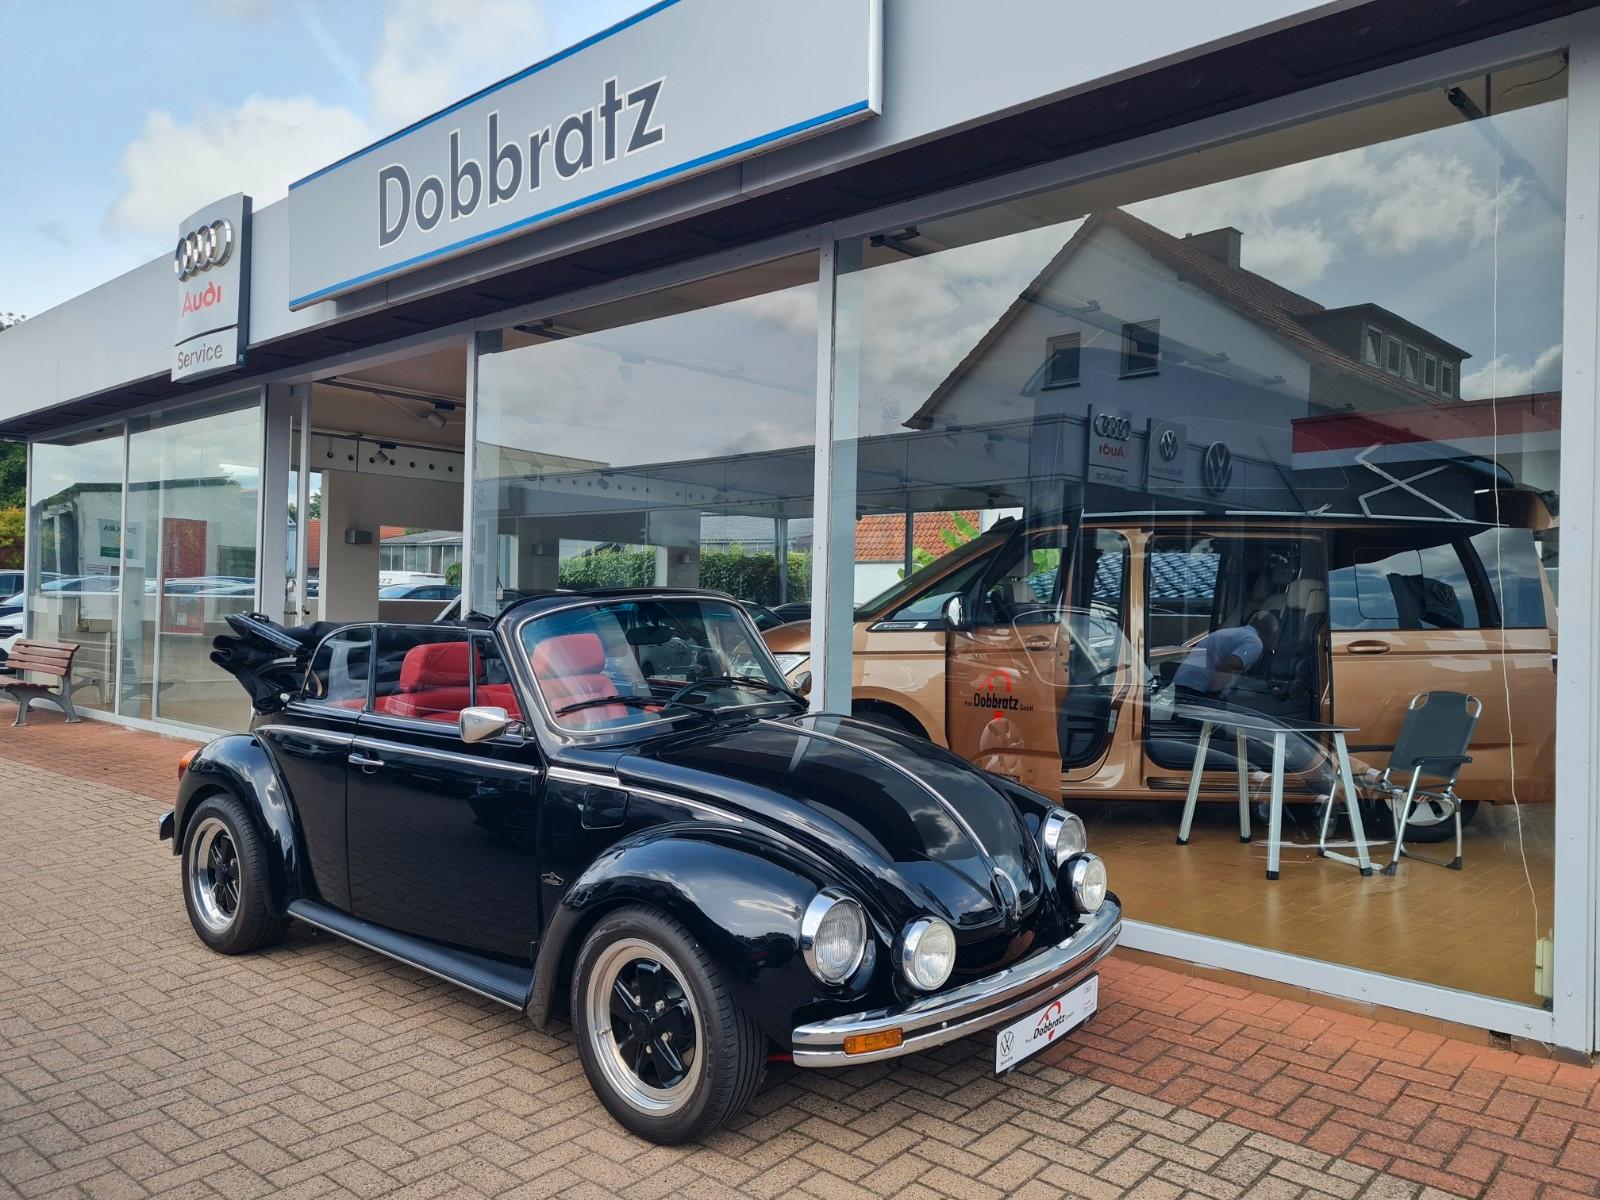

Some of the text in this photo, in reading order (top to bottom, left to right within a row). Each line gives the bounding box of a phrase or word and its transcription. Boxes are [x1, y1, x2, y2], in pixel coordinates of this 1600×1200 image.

[378, 75, 667, 248] Dobbratz
[181, 281, 221, 317] Audi
[177, 343, 223, 370] Service
[973, 692, 1019, 711] Dobbratz
[1033, 1014, 1066, 1040] Dobbratz
